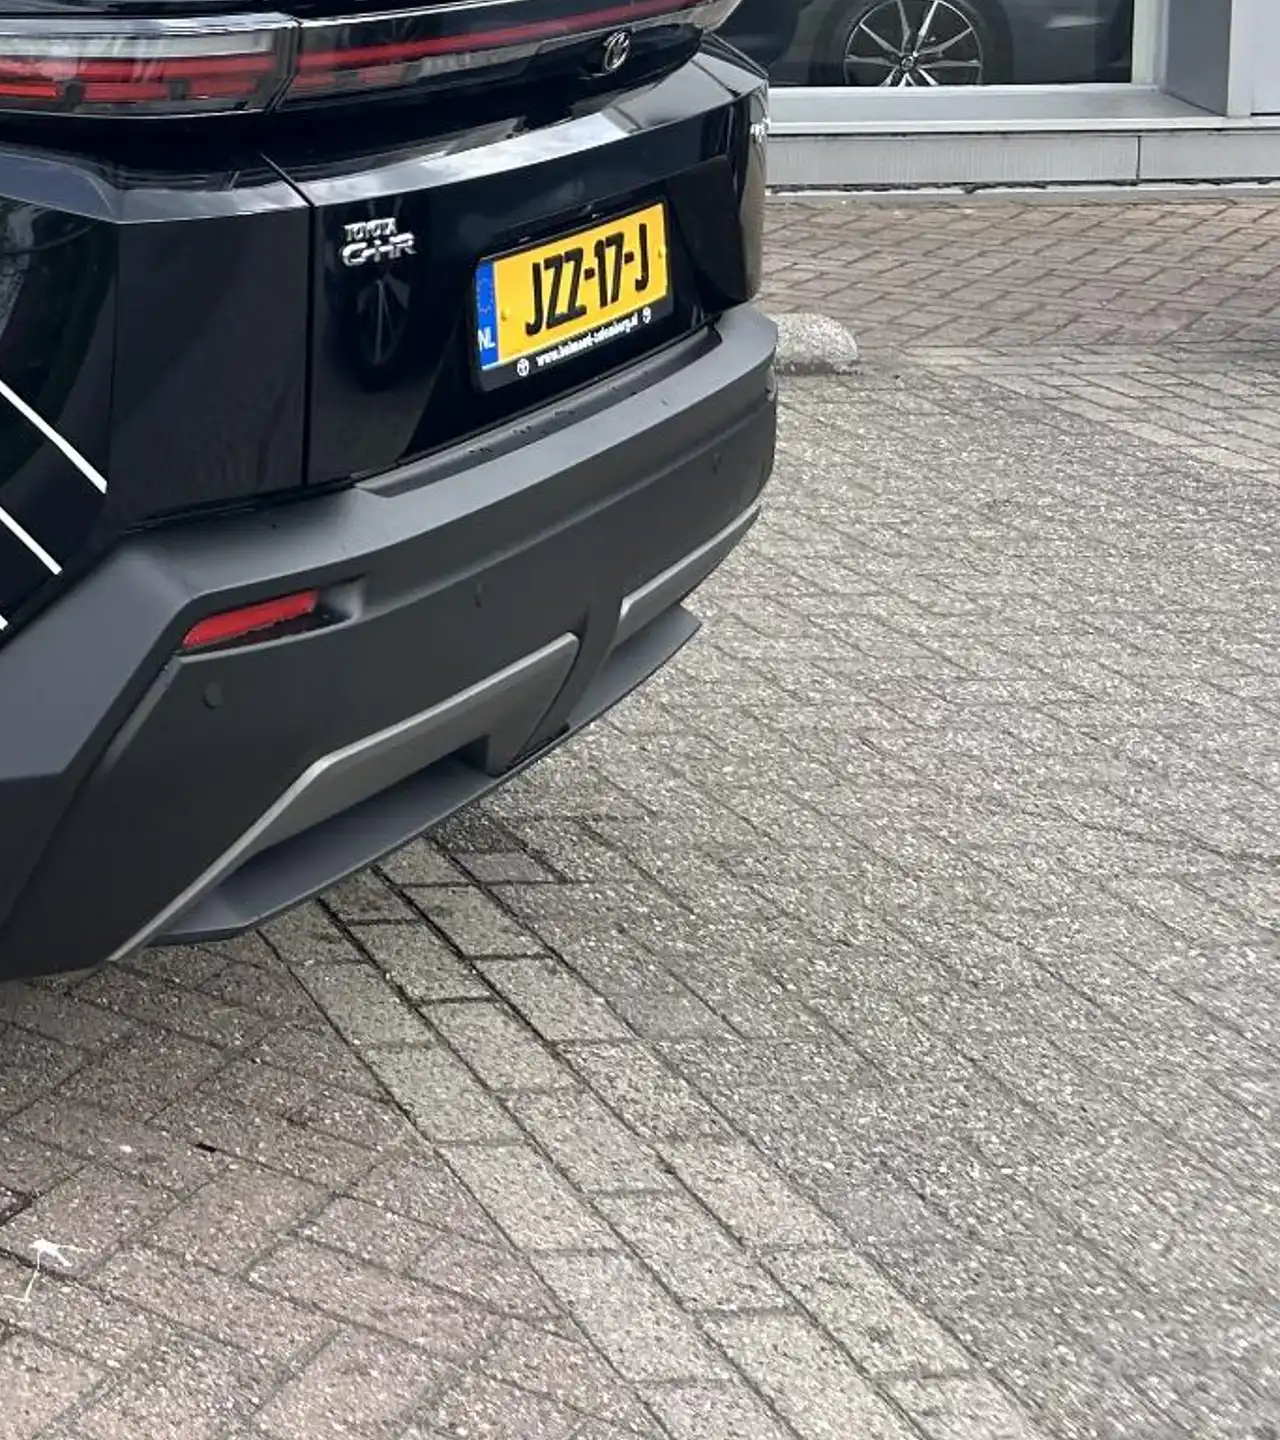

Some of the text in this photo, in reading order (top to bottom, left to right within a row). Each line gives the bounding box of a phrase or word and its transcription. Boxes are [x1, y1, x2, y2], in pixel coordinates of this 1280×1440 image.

[343, 216, 398, 242] TOYOTA
[524, 222, 650, 338] JZZ-17-J
[477, 328, 496, 352] NL
